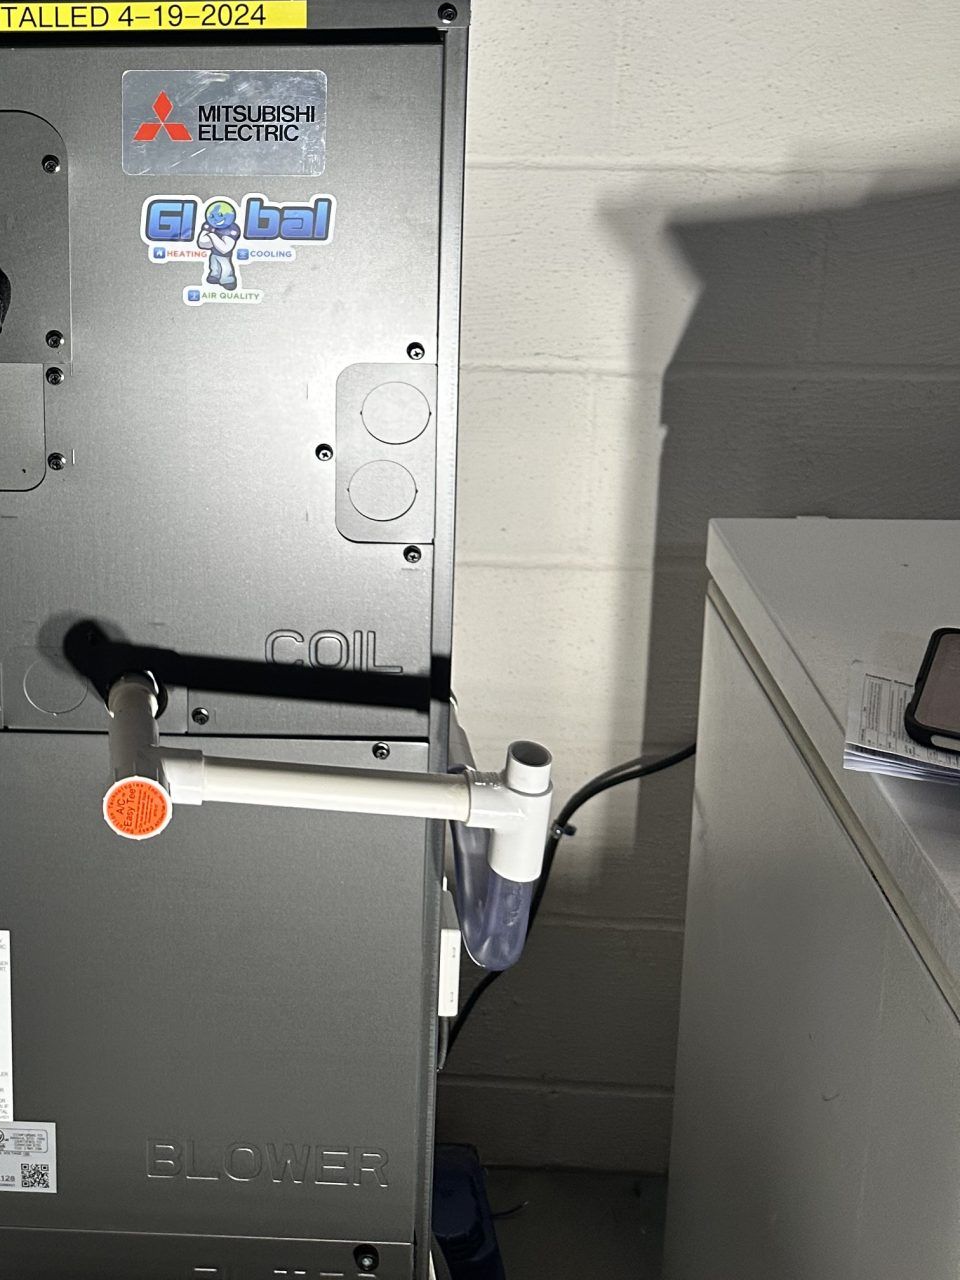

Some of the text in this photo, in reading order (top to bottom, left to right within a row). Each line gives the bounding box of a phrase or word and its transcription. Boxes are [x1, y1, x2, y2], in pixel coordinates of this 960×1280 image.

[118, 4, 266, 27] 4-19-2024
[198, 105, 315, 123] MITSUBISHI
[198, 124, 299, 141] ELECTRIC
[166, 250, 208, 258] HEATING
[249, 250, 292, 258] COOLING
[201, 292, 260, 301] AIR QUALITY
[264, 629, 403, 674] COIL
[124, 789, 136, 826] Easy Tee
[147, 1138, 388, 1187] BLOWER
